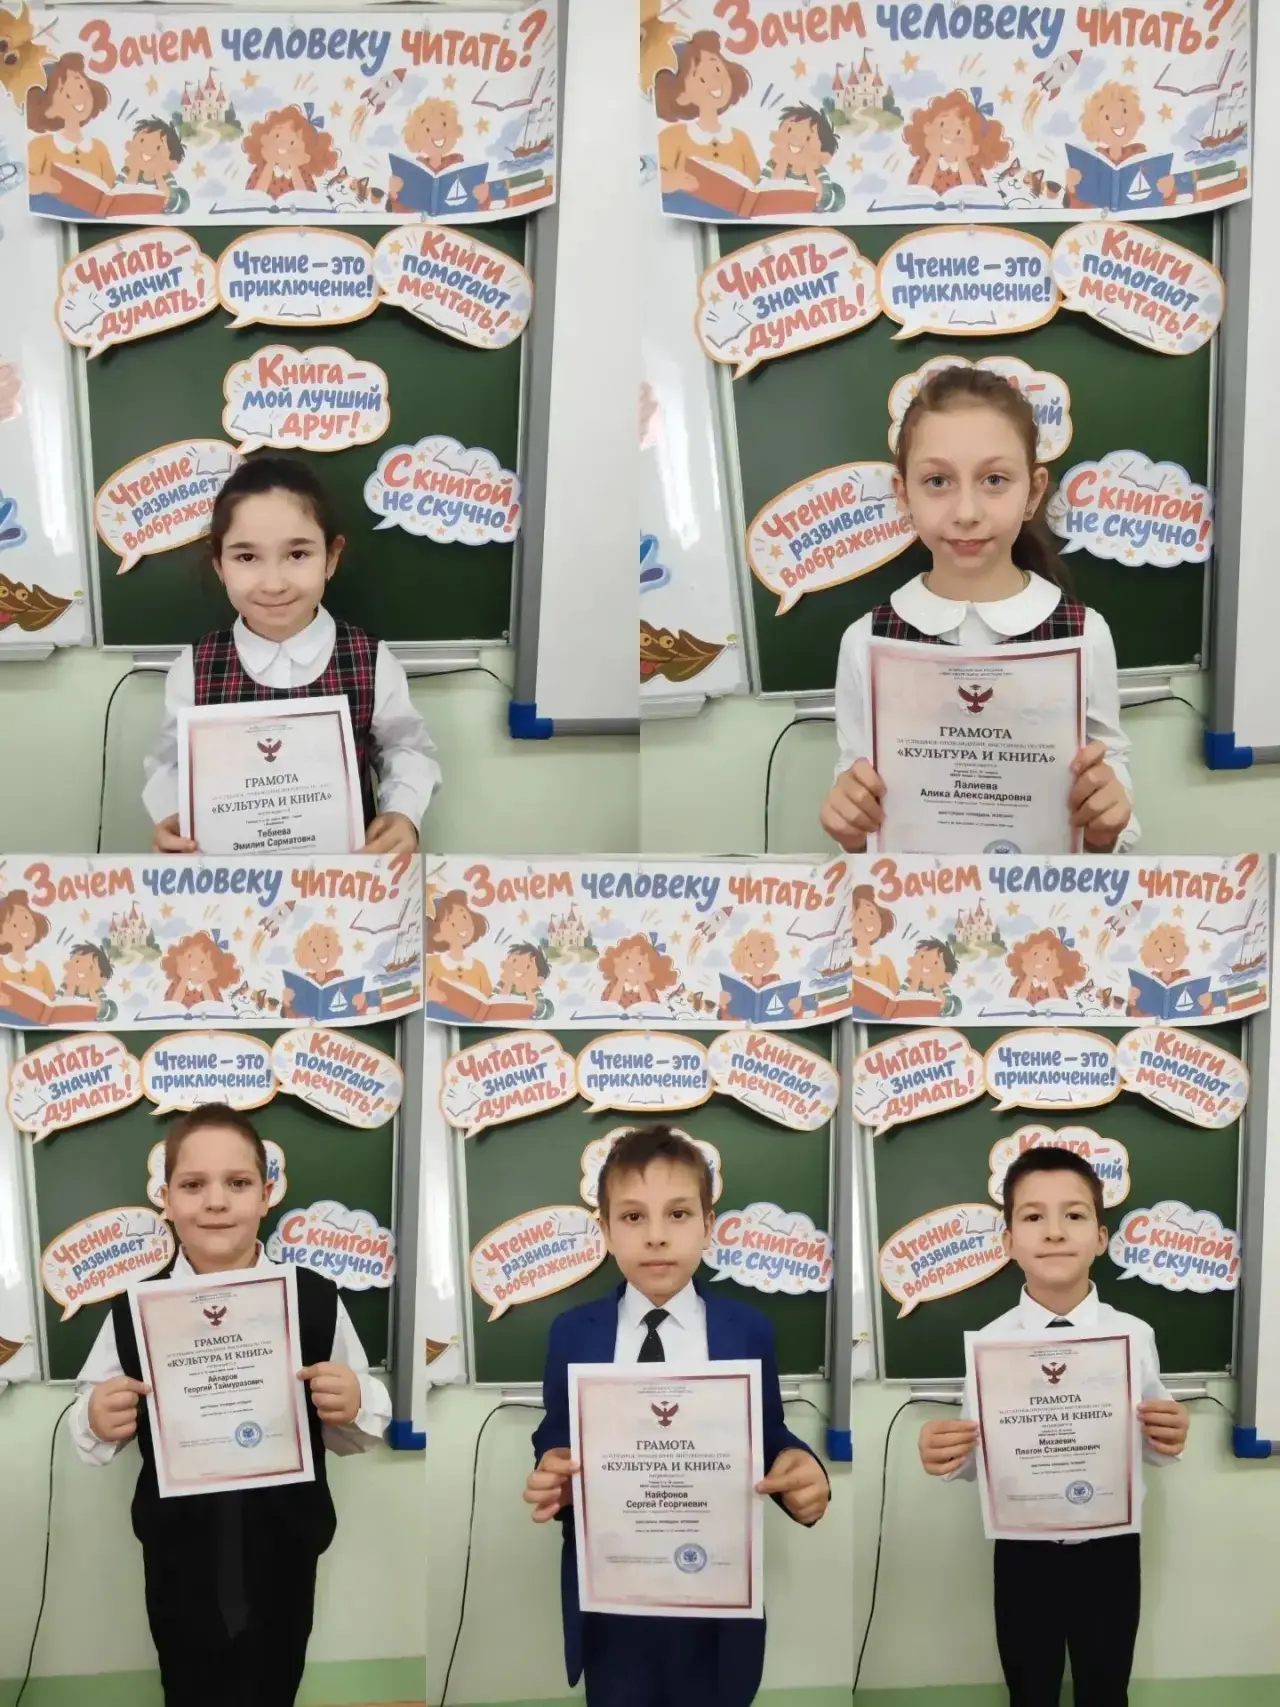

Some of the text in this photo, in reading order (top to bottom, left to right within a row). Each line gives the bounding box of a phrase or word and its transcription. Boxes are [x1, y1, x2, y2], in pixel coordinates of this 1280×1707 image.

[79, 10, 548, 76] Зачем человеку читать?
[720, 0, 1232, 58] Зачем человеку читать?
[234, 250, 306, 276] Чтение
[332, 258, 365, 275] это
[420, 232, 505, 281] Книги
[896, 252, 979, 278] Чтение
[1005, 258, 1042, 276] это
[1100, 228, 1194, 281] Книги
[108, 268, 182, 308] значит
[228, 275, 372, 306] приключение!
[402, 254, 510, 308] помогают
[754, 272, 839, 318] значит
[892, 280, 1051, 306] приключение!
[1082, 252, 1200, 311] помогают
[98, 278, 206, 341] думать!
[398, 276, 509, 334] мечтать!
[744, 285, 866, 356] думать!
[1078, 276, 1198, 338] мечтать!
[258, 353, 342, 388] Книга
[242, 385, 381, 413] мой лучший
[109, 456, 193, 508] Чтение
[131, 477, 219, 527] развивает
[413, 468, 513, 506] книгой
[382, 492, 519, 532] не скучно!
[762, 481, 856, 541] Чтение
[1099, 485, 1204, 526] книгой
[788, 503, 885, 561] развивает
[1065, 510, 1210, 552] не скучно!
[939, 726, 1012, 739] ГРАМОТА
[897, 748, 1055, 763] «КУЛЬТУРА И КНИГА»
[245, 773, 298, 788] ГРАМОТА
[920, 789, 1032, 802] Алика Александровна
[212, 798, 275, 814] «КУЛЬТУРА
[278, 797, 286, 806] И
[290, 792, 332, 805] КНИГА»
[233, 840, 265, 851] Эмилия
[267, 834, 316, 847] Сарматовна
[257, 828, 291, 838] Тебиева
[24, 853, 411, 907] Зачем человеку читать?
[464, 861, 847, 912] Зачем человеку читать?
[870, 853, 1259, 906] Зачем человеку читать?
[155, 1051, 217, 1070] Чтение
[237, 1055, 264, 1069] это
[309, 1032, 380, 1074] Книги
[590, 1050, 653, 1070] Чтение
[673, 1056, 700, 1070] это
[745, 1036, 816, 1077] Книги
[998, 1047, 1062, 1067] Чтение
[1081, 1053, 1109, 1066] это
[1140, 1050, 1231, 1095] помогают
[1155, 1031, 1226, 1075] Книги
[48, 1066, 112, 1100] значит
[151, 1070, 271, 1091] приключение!
[291, 1072, 384, 1115] мечтать!
[295, 1052, 385, 1096] помогают
[482, 1063, 547, 1096] значит
[587, 1071, 706, 1090] приключение!
[731, 1054, 821, 1098] помогают
[890, 1061, 955, 1094] значит
[994, 1068, 1115, 1089] приключение!
[1136, 1068, 1225, 1117] мечтать!
[41, 1075, 131, 1126] думать!
[474, 1072, 566, 1124] думать!
[728, 1071, 819, 1120] мечтать!
[883, 1071, 974, 1121] думать!
[53, 1222, 123, 1265] Чтение
[72, 1238, 144, 1280] развивает
[306, 1230, 389, 1259] книгой
[481, 1221, 555, 1264] Чтение
[501, 1238, 575, 1279] развивает
[742, 1232, 826, 1261] книгой
[890, 1218, 963, 1263] Чтение
[910, 1235, 984, 1277] развивает
[1150, 1229, 1234, 1259] книгой
[281, 1247, 393, 1279] не скучно!
[717, 1249, 831, 1283] не скучно!
[1124, 1247, 1239, 1281] не скучно!
[168, 1354, 221, 1367] «КУЛЬТУРА
[236, 1348, 273, 1359] КНИГА»
[194, 1334, 243, 1347] ГРАМОТА
[184, 1384, 212, 1394] Георгий
[214, 1379, 264, 1391] Таймуразович
[1030, 1394, 1081, 1405] ГРАМОТА
[1000, 1413, 1057, 1424] «КУЛЬТУРА
[1073, 1410, 1112, 1420] КНИГА»
[636, 1440, 695, 1450] ГРАМОТА
[1044, 1444, 1100, 1453] Станиславович
[602, 1462, 731, 1472] «КУЛЬТУРА И КНИГА»
[626, 1500, 708, 1509] Сергей Георгиевич
[645, 1490, 688, 1499] Найфонов
